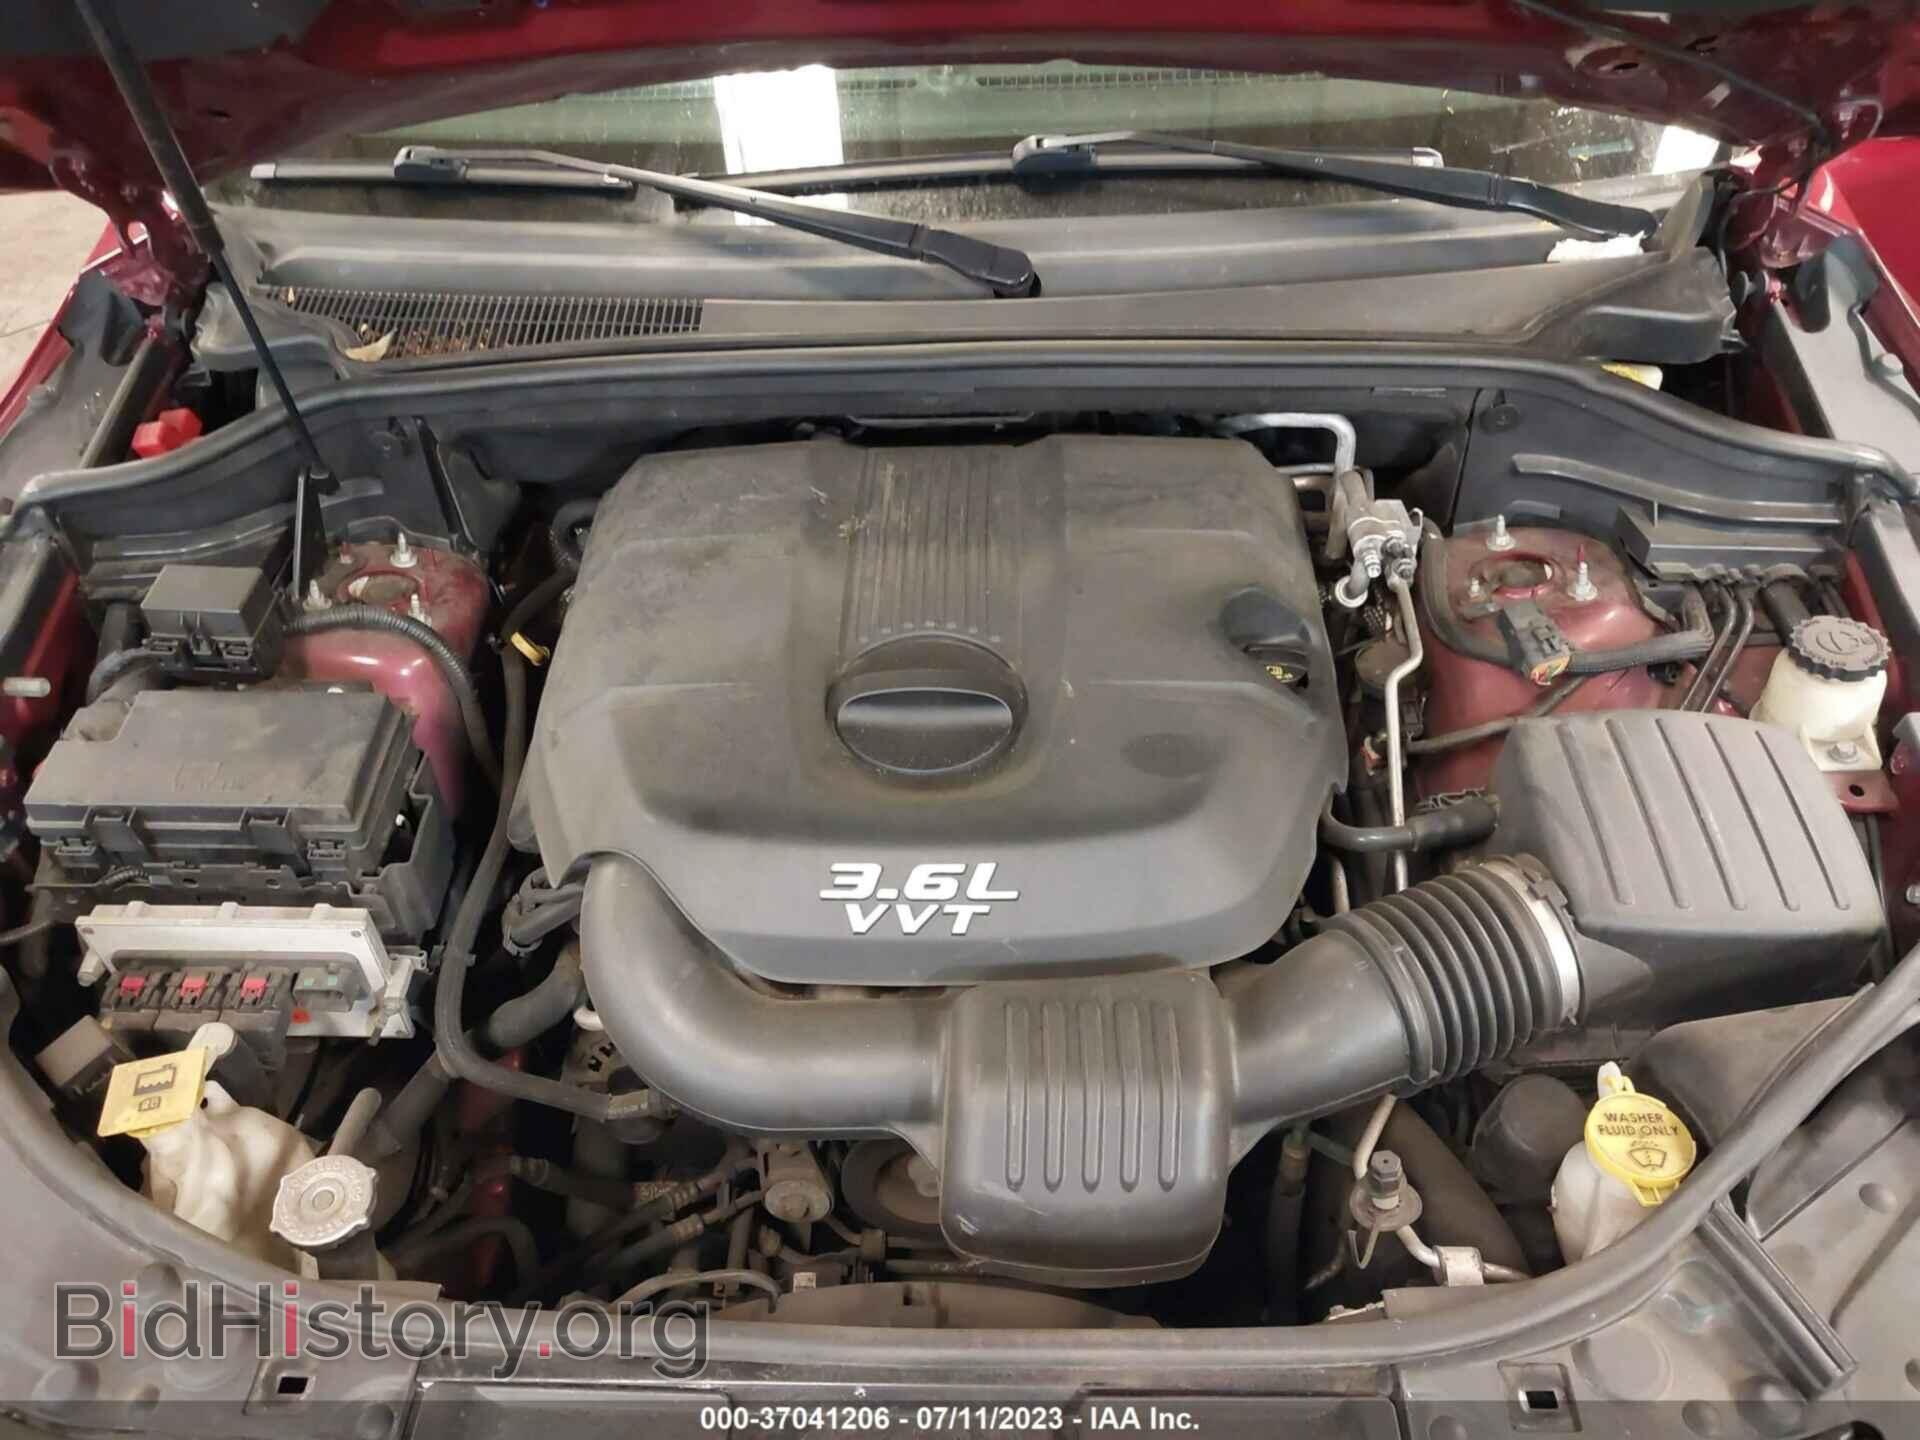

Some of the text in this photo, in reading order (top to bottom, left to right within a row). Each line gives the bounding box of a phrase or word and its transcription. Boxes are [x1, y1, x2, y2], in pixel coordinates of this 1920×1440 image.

[819, 862, 1021, 901] 3.6L
[845, 903, 992, 936] VVT
[1603, 1111, 1665, 1123] WASHER
[1597, 1124, 1680, 1136] FLUID ONLY
